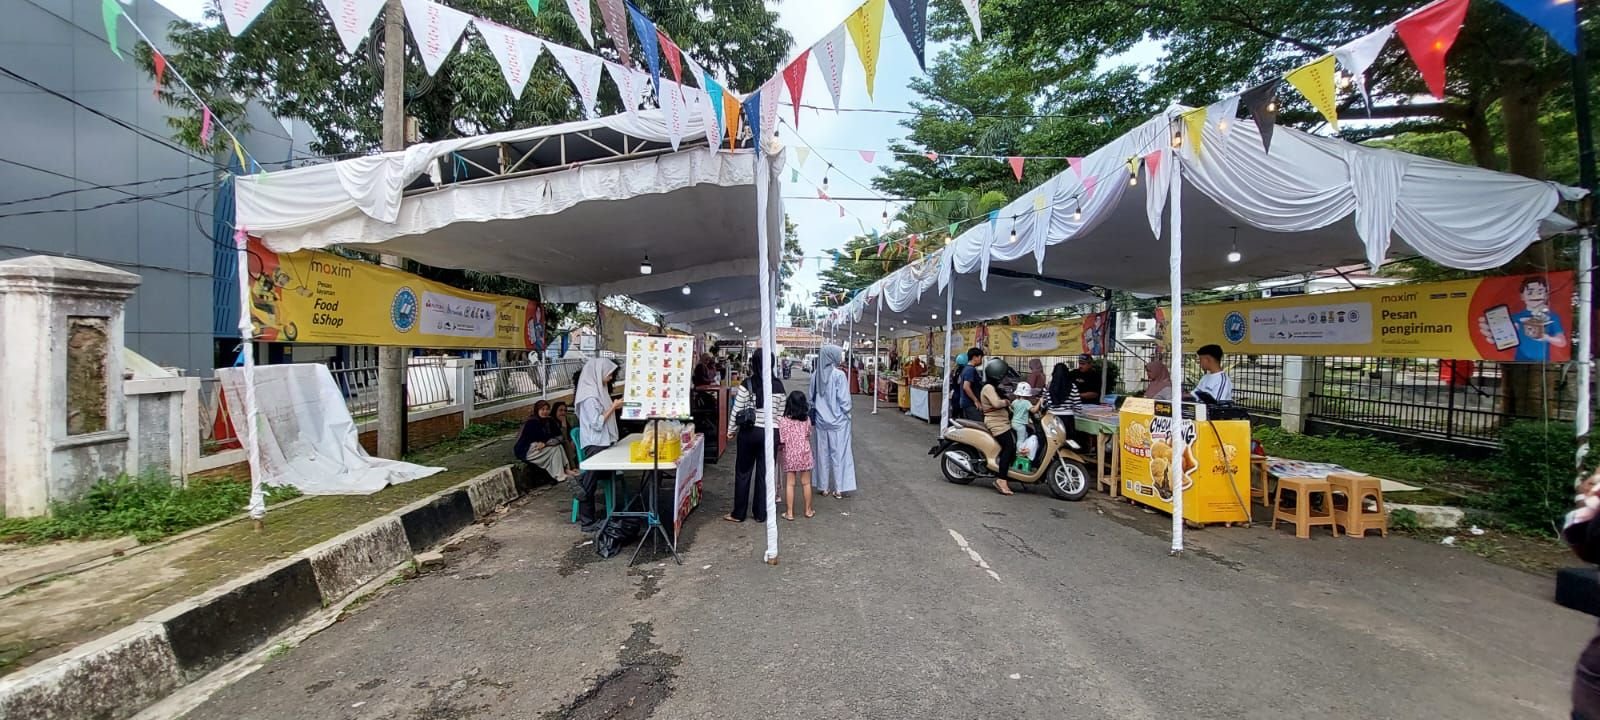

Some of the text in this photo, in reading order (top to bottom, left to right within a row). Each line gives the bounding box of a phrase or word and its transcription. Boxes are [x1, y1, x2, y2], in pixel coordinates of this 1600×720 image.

[311, 260, 351, 278] maxim
[1381, 291, 1416, 304] maxim
[314, 298, 339, 312] Food
[312, 313, 344, 328] &Shop
[1381, 309, 1417, 320] Pesan
[1381, 322, 1453, 336] pengiriman
